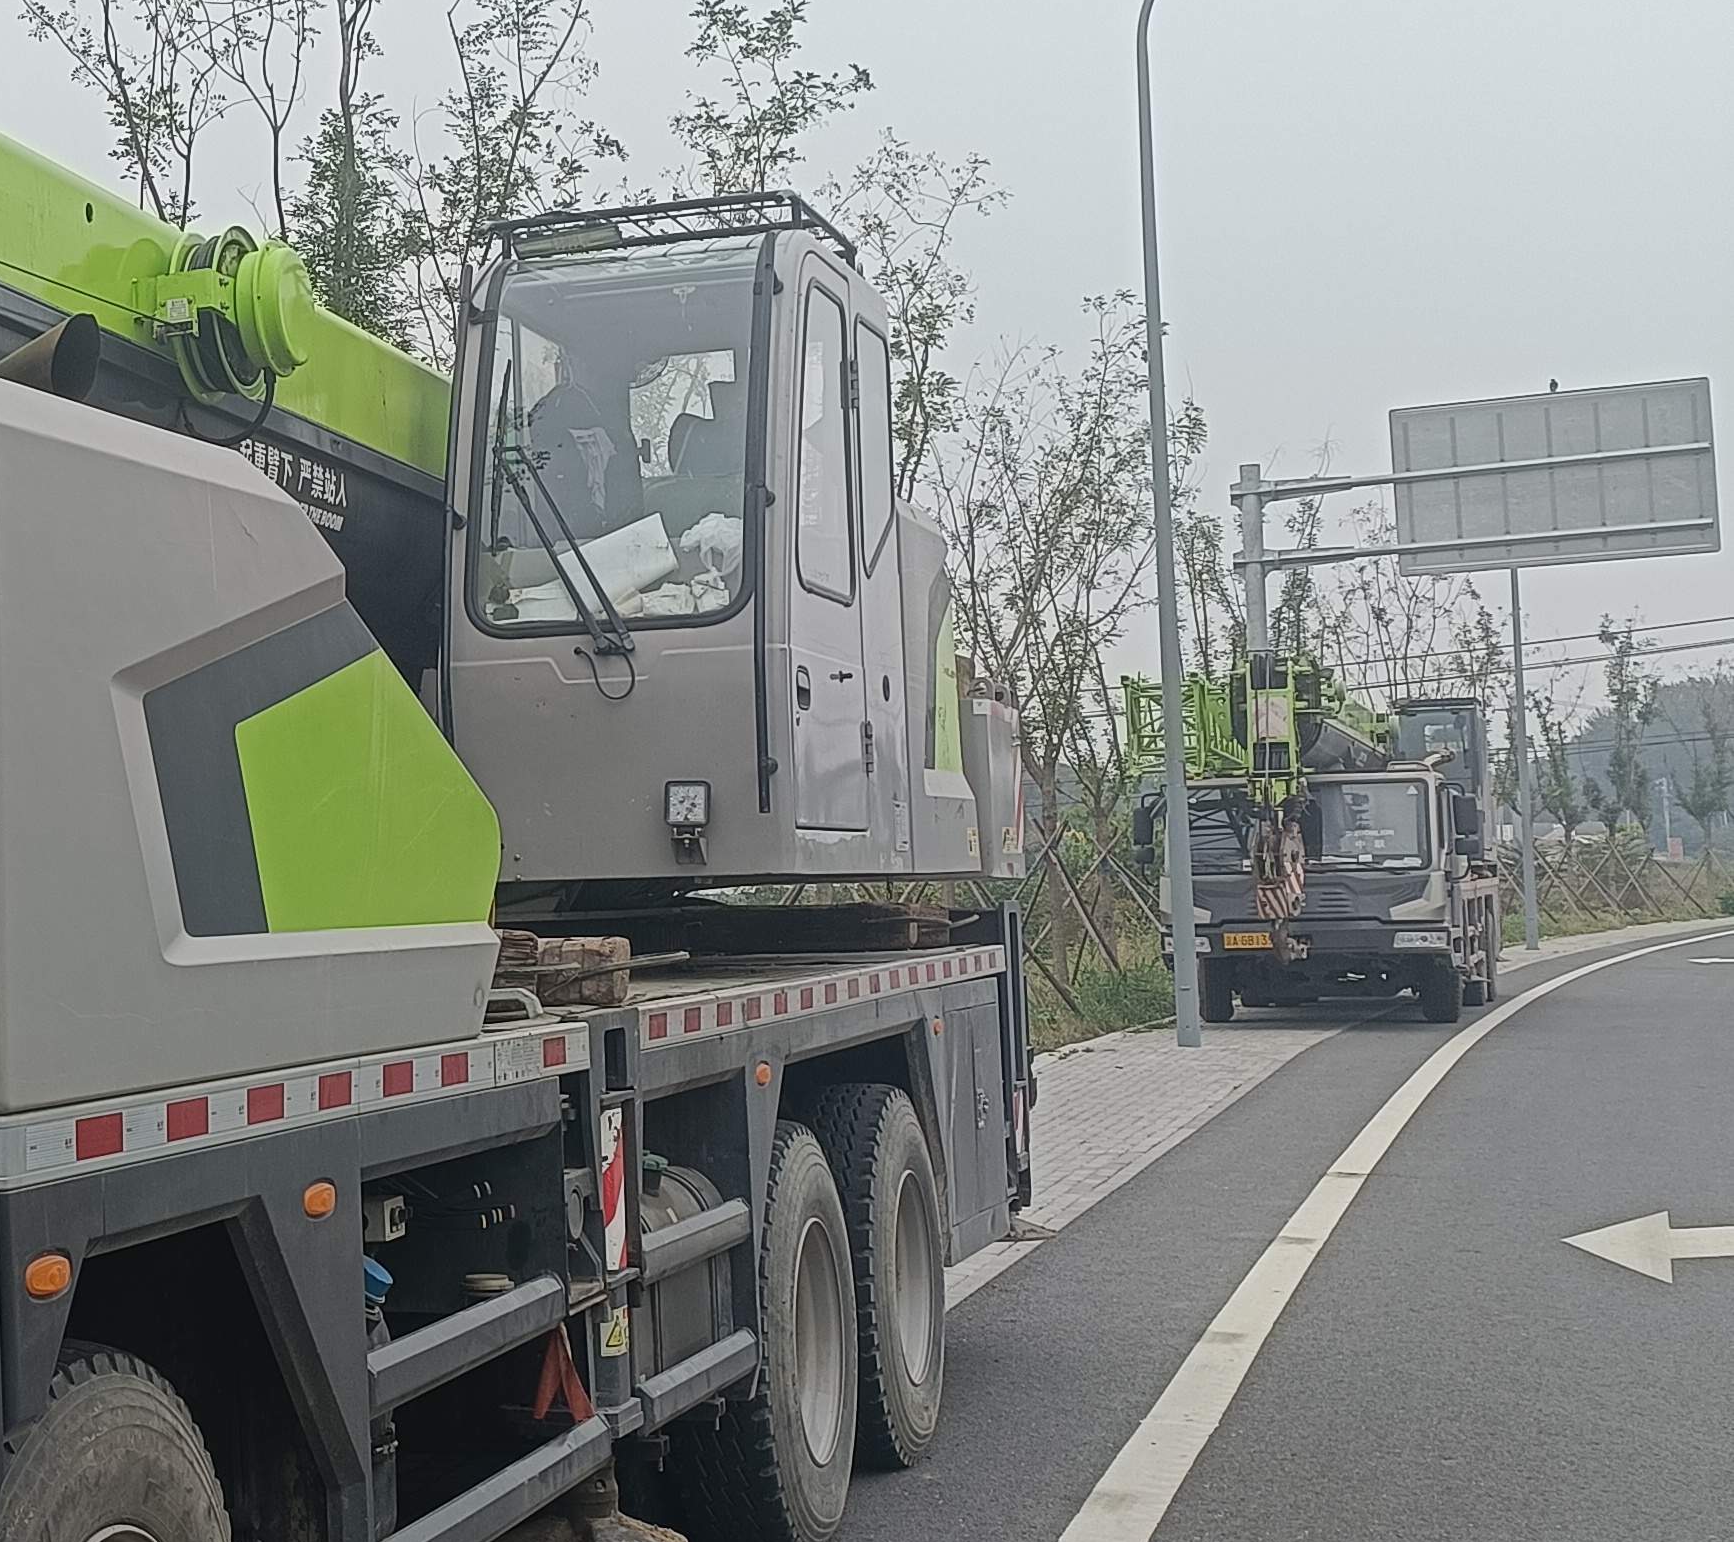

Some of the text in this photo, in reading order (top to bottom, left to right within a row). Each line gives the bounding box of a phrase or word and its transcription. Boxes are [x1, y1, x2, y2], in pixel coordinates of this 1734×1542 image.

[297, 457, 347, 509] 严禁站人
[319, 510, 344, 532] BOOM
